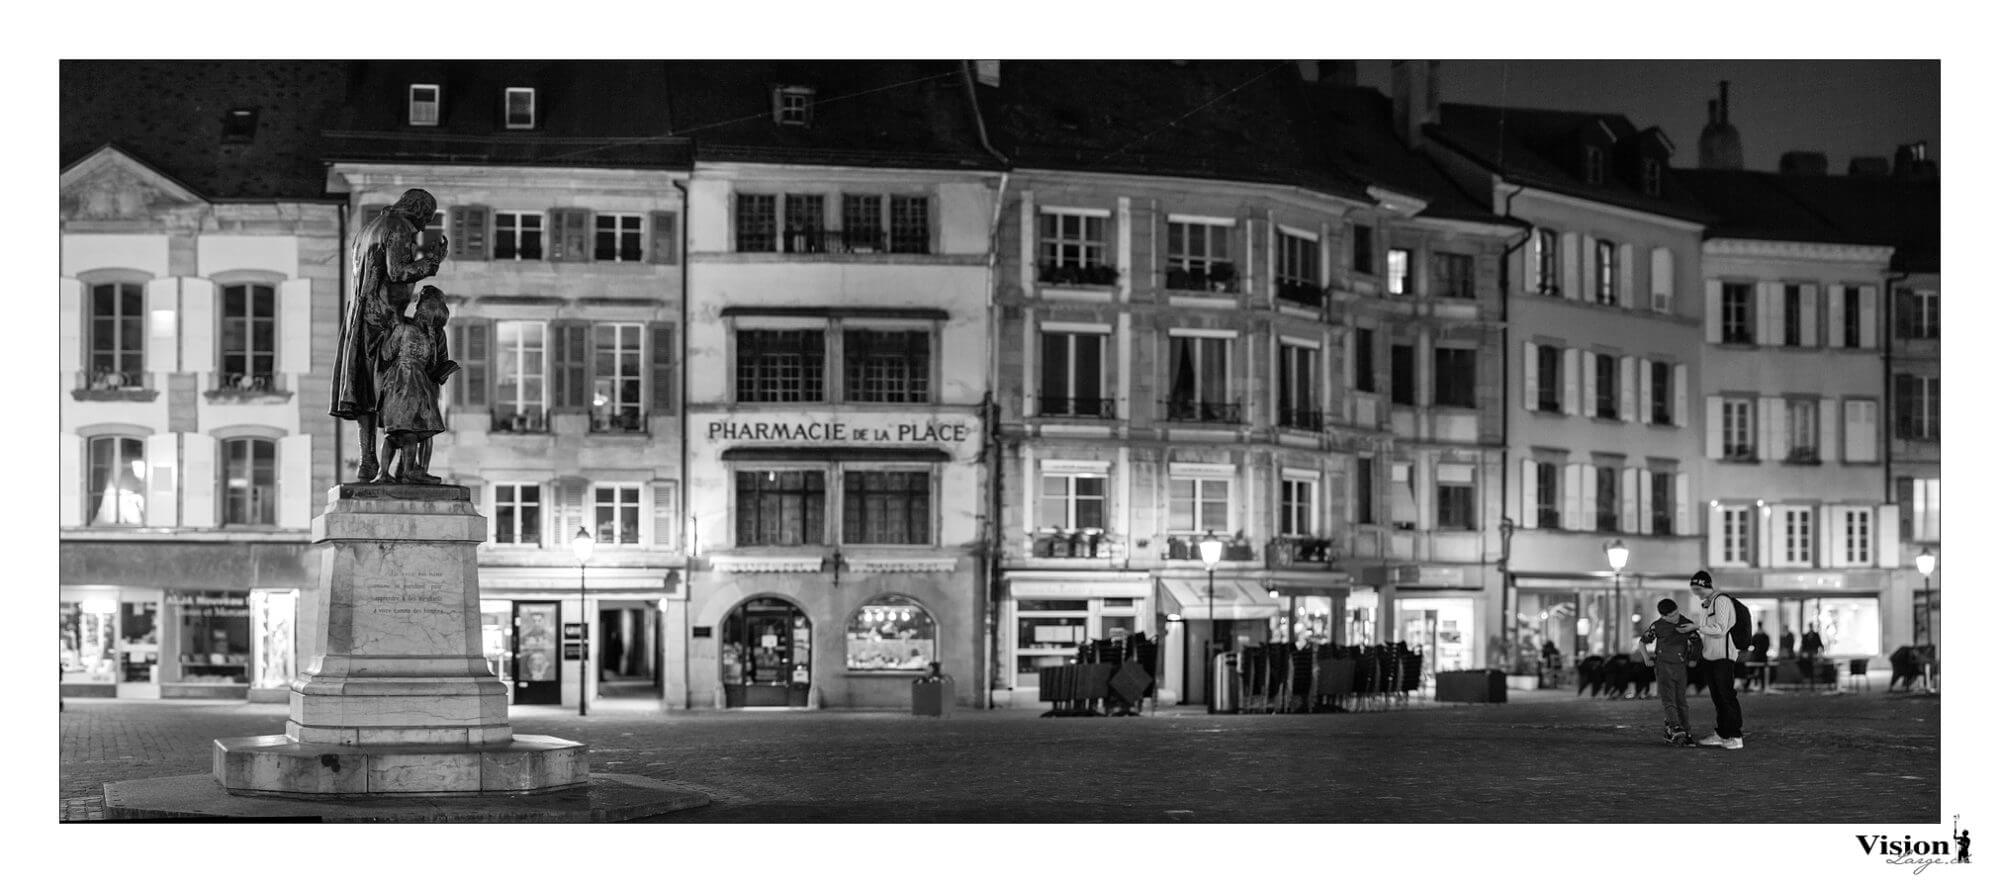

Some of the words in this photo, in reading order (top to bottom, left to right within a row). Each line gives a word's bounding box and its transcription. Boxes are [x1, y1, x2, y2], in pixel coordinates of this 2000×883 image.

[708, 422, 846, 441] PHARMACIE
[853, 428, 868, 441] DE
[874, 429, 890, 441] LA
[898, 424, 966, 442] PLACE
